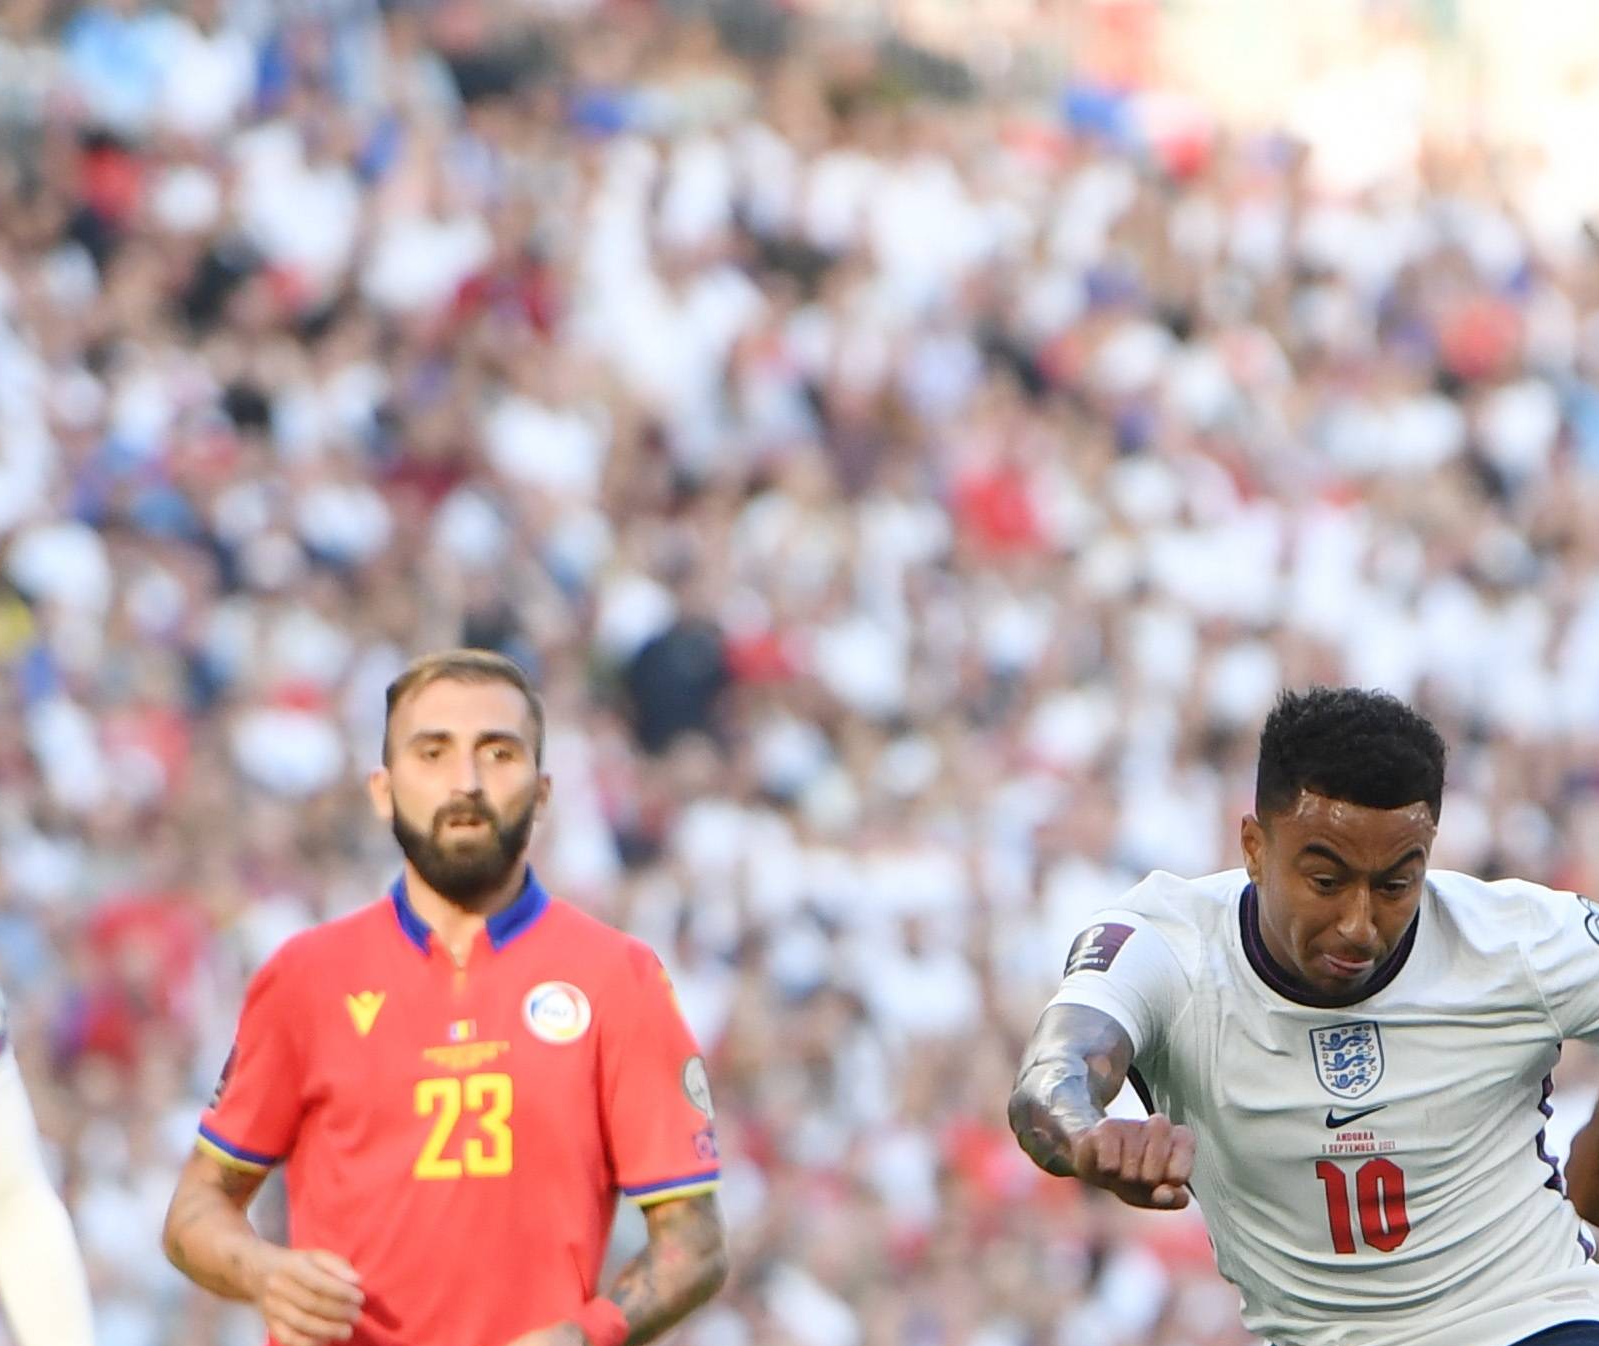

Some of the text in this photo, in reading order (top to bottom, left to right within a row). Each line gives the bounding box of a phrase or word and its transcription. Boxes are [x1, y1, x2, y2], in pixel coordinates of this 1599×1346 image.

[413, 1074, 514, 1180] 23
[1329, 1142, 1376, 1154] SEPTEMBER
[1336, 1131, 1374, 1141] ANDORRA
[1315, 1157, 1411, 1254] 10
